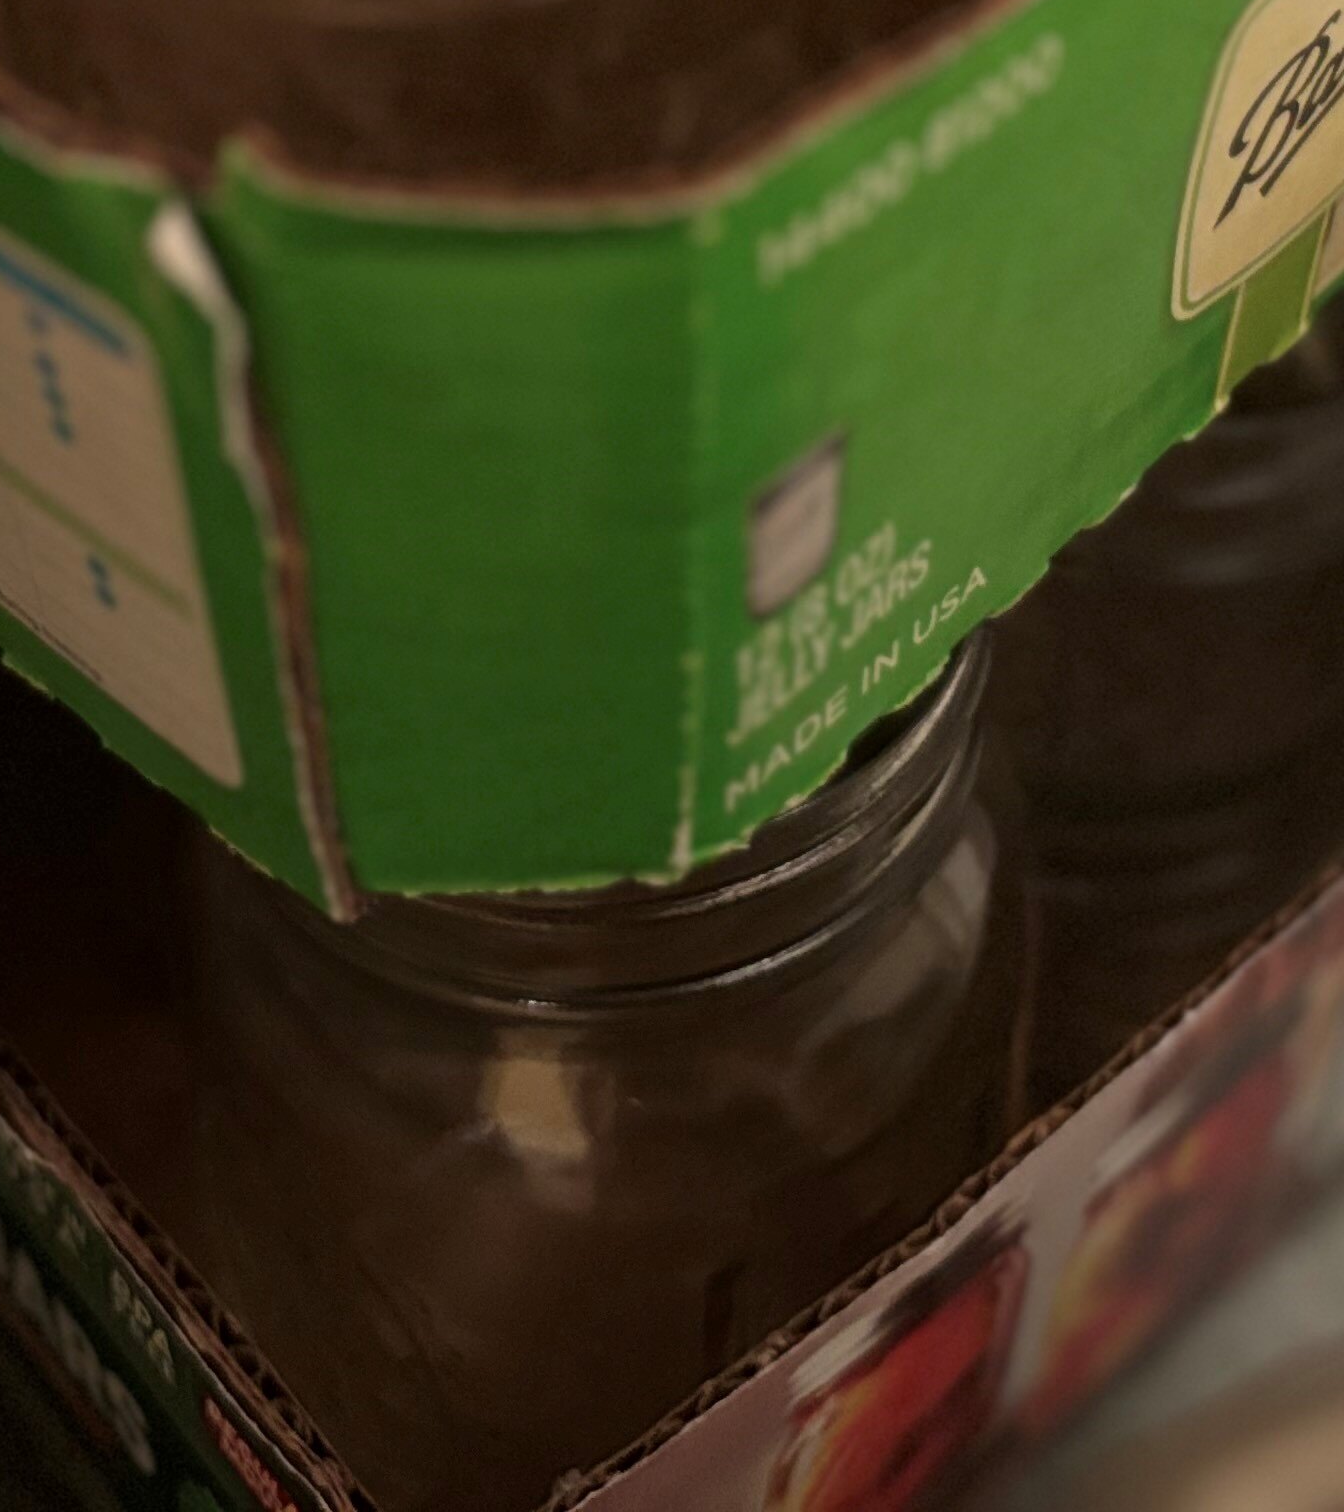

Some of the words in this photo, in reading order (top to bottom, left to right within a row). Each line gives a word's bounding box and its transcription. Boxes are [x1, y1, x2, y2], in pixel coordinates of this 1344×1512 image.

[840, 539, 933, 650] JARS
[724, 685, 848, 813] MADE
[861, 639, 900, 695] IN
[912, 565, 987, 645] USA
